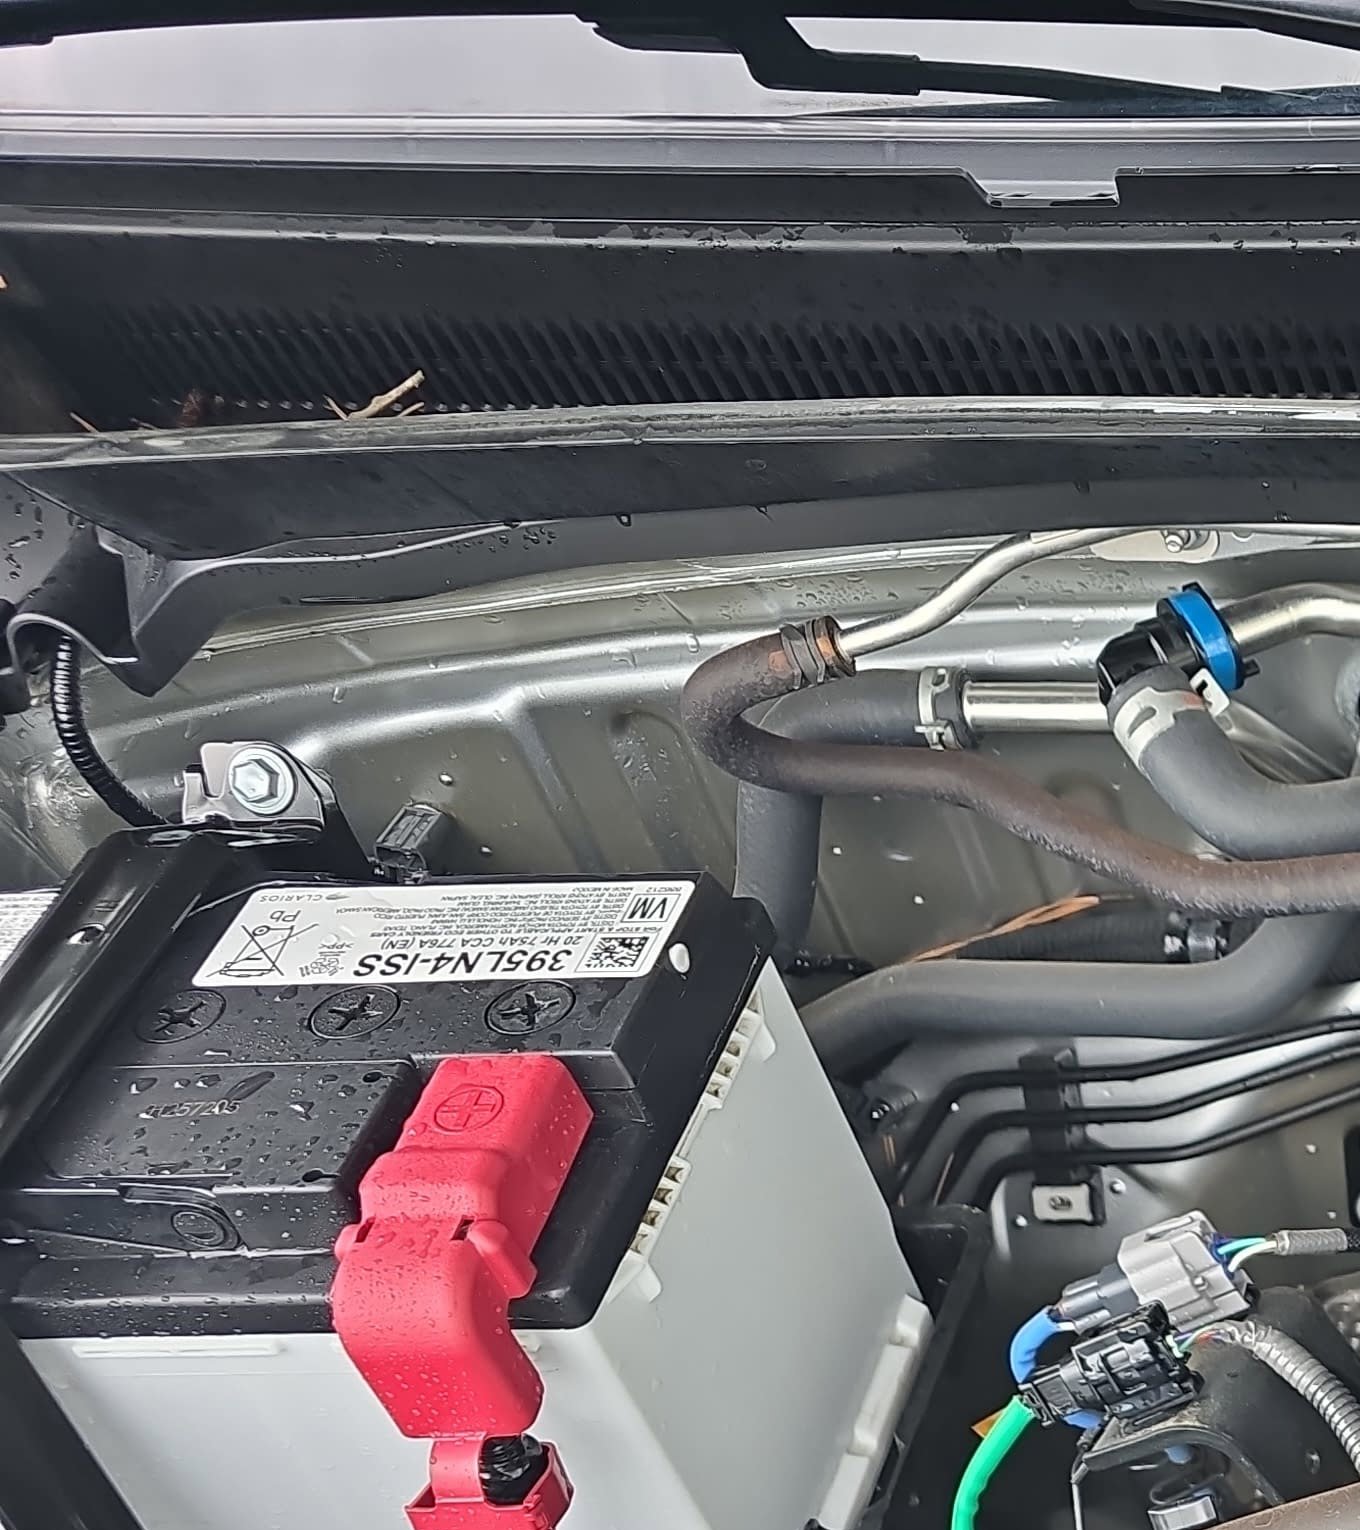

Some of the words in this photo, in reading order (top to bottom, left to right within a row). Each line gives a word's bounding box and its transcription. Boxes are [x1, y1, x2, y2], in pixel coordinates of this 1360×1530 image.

[258, 894, 323, 902] CLARIOS
[627, 897, 668, 920] VM
[267, 910, 301, 922] Pb
[380, 937, 416, 949] (EN)
[419, 937, 457, 948] 776A
[461, 937, 494, 947] CCA
[499, 936, 538, 946] 75Ah
[540, 936, 560, 946] Hr
[563, 936, 584, 946] 20
[353, 950, 572, 977] 395LN4-ISS
